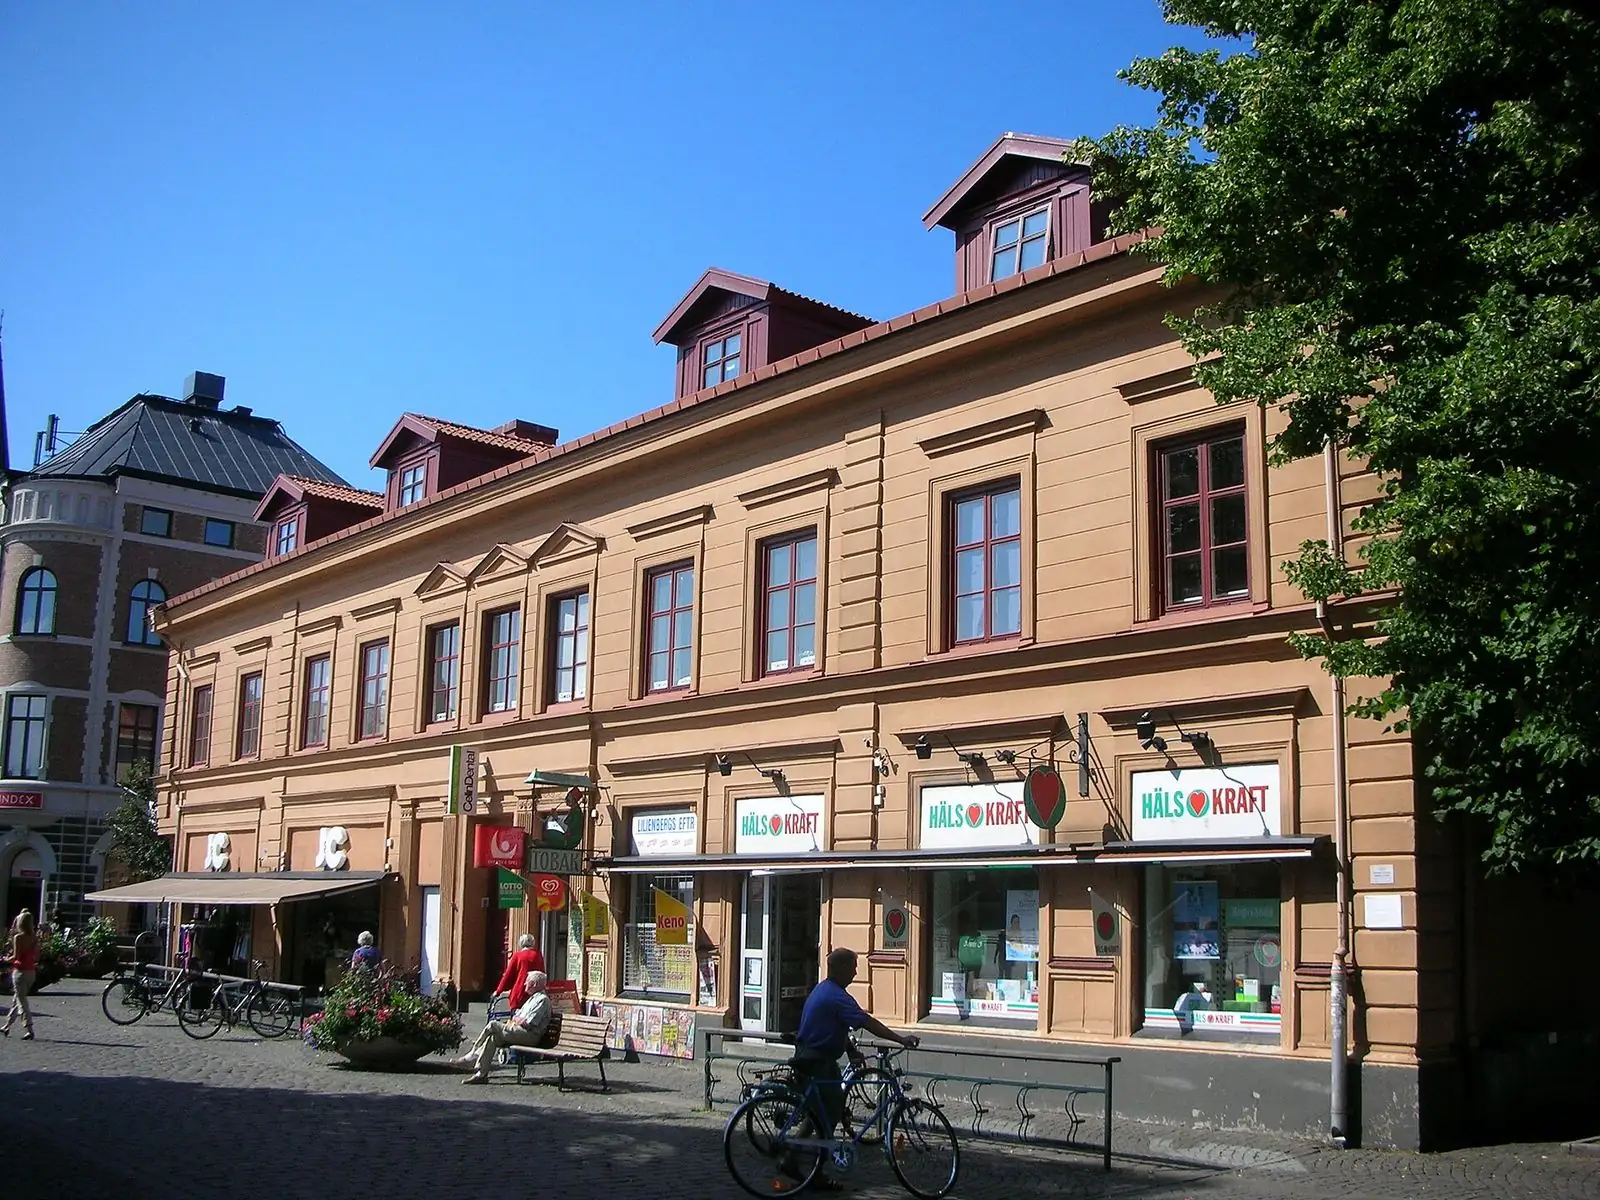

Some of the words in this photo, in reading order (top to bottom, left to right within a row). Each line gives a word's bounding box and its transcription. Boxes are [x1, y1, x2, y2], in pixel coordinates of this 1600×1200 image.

[1142, 788, 1184, 819] HÄLS
[1212, 786, 1269, 815] KRAFT
[679, 816, 695, 830] EFTR
[742, 811, 768, 836] HÄLS
[784, 812, 819, 834] KRAFT
[929, 801, 963, 828] HÄLS
[315, 826, 348, 869] JC
[533, 849, 580, 871] TOBAK
[500, 882, 523, 890] LOTTO
[657, 915, 685, 928] Keno
